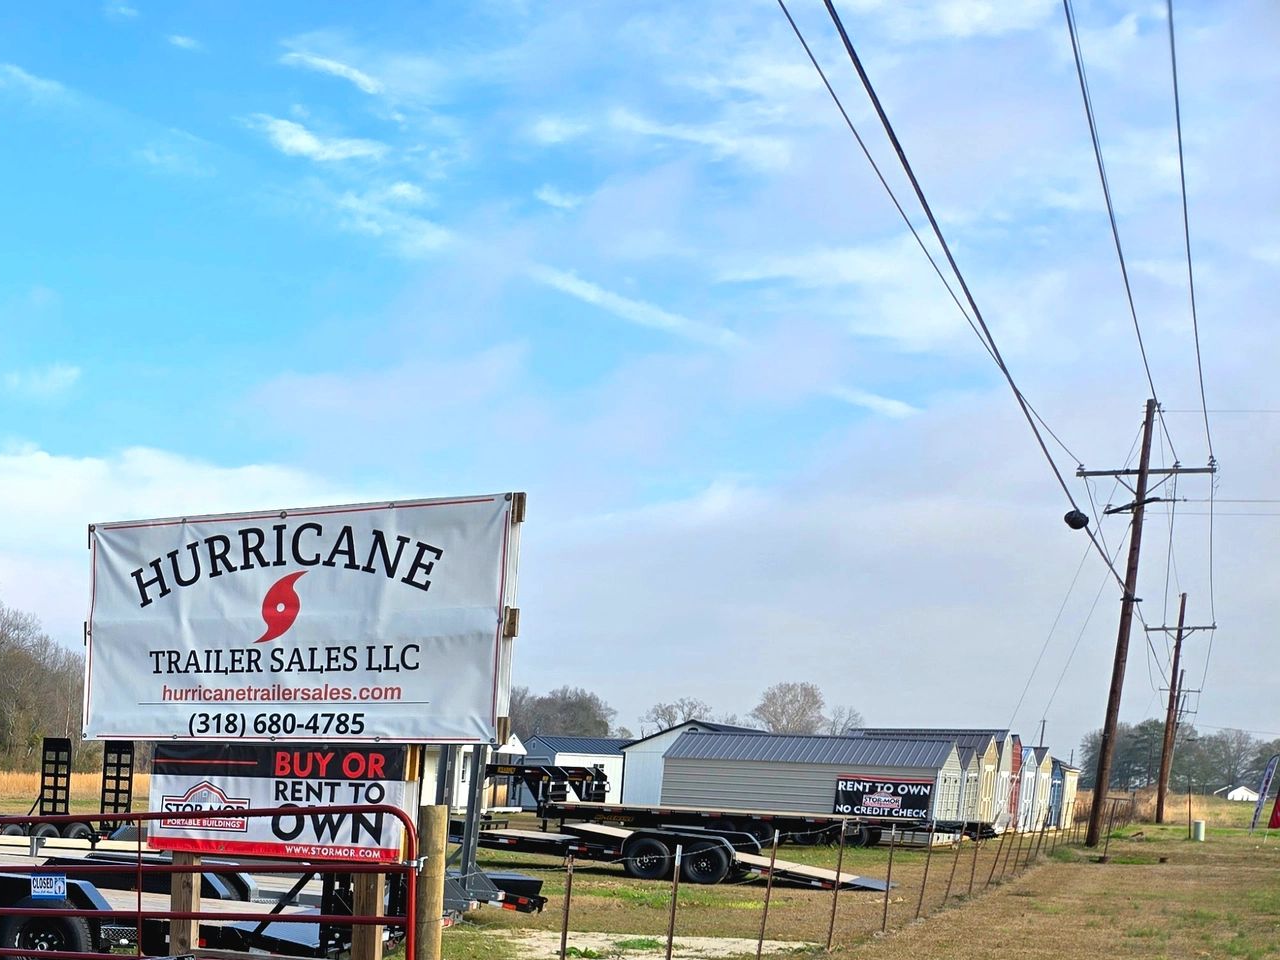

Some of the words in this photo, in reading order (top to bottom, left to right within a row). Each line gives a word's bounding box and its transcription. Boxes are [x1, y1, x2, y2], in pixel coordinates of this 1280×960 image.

[130, 522, 444, 608] HURRICANE
[149, 649, 264, 675] TRAILER
[270, 646, 358, 674] SALES
[365, 644, 420, 673] LLC
[162, 684, 402, 702] hurricanetrailersales.com
[188, 712, 247, 738] (318)
[253, 712, 365, 735] 680-4785
[274, 752, 335, 777] BUY
[342, 752, 385, 778] OR
[274, 781, 342, 802] RENT
[348, 782, 385, 804] TO
[837, 780, 872, 793] RENT
[875, 783, 894, 794] TO
[897, 784, 931, 796] OWN
[835, 804, 851, 813] NO
[853, 806, 890, 816] CREDIT
[892, 808, 927, 818] CHECK
[167, 818, 201, 826] PORTABLE
[202, 819, 241, 828] BUILDINGS
[271, 803, 383, 846] OWN
[285, 845, 381, 859] WWW.STORMOR.COM
[32, 877, 54, 889] CLOSED
